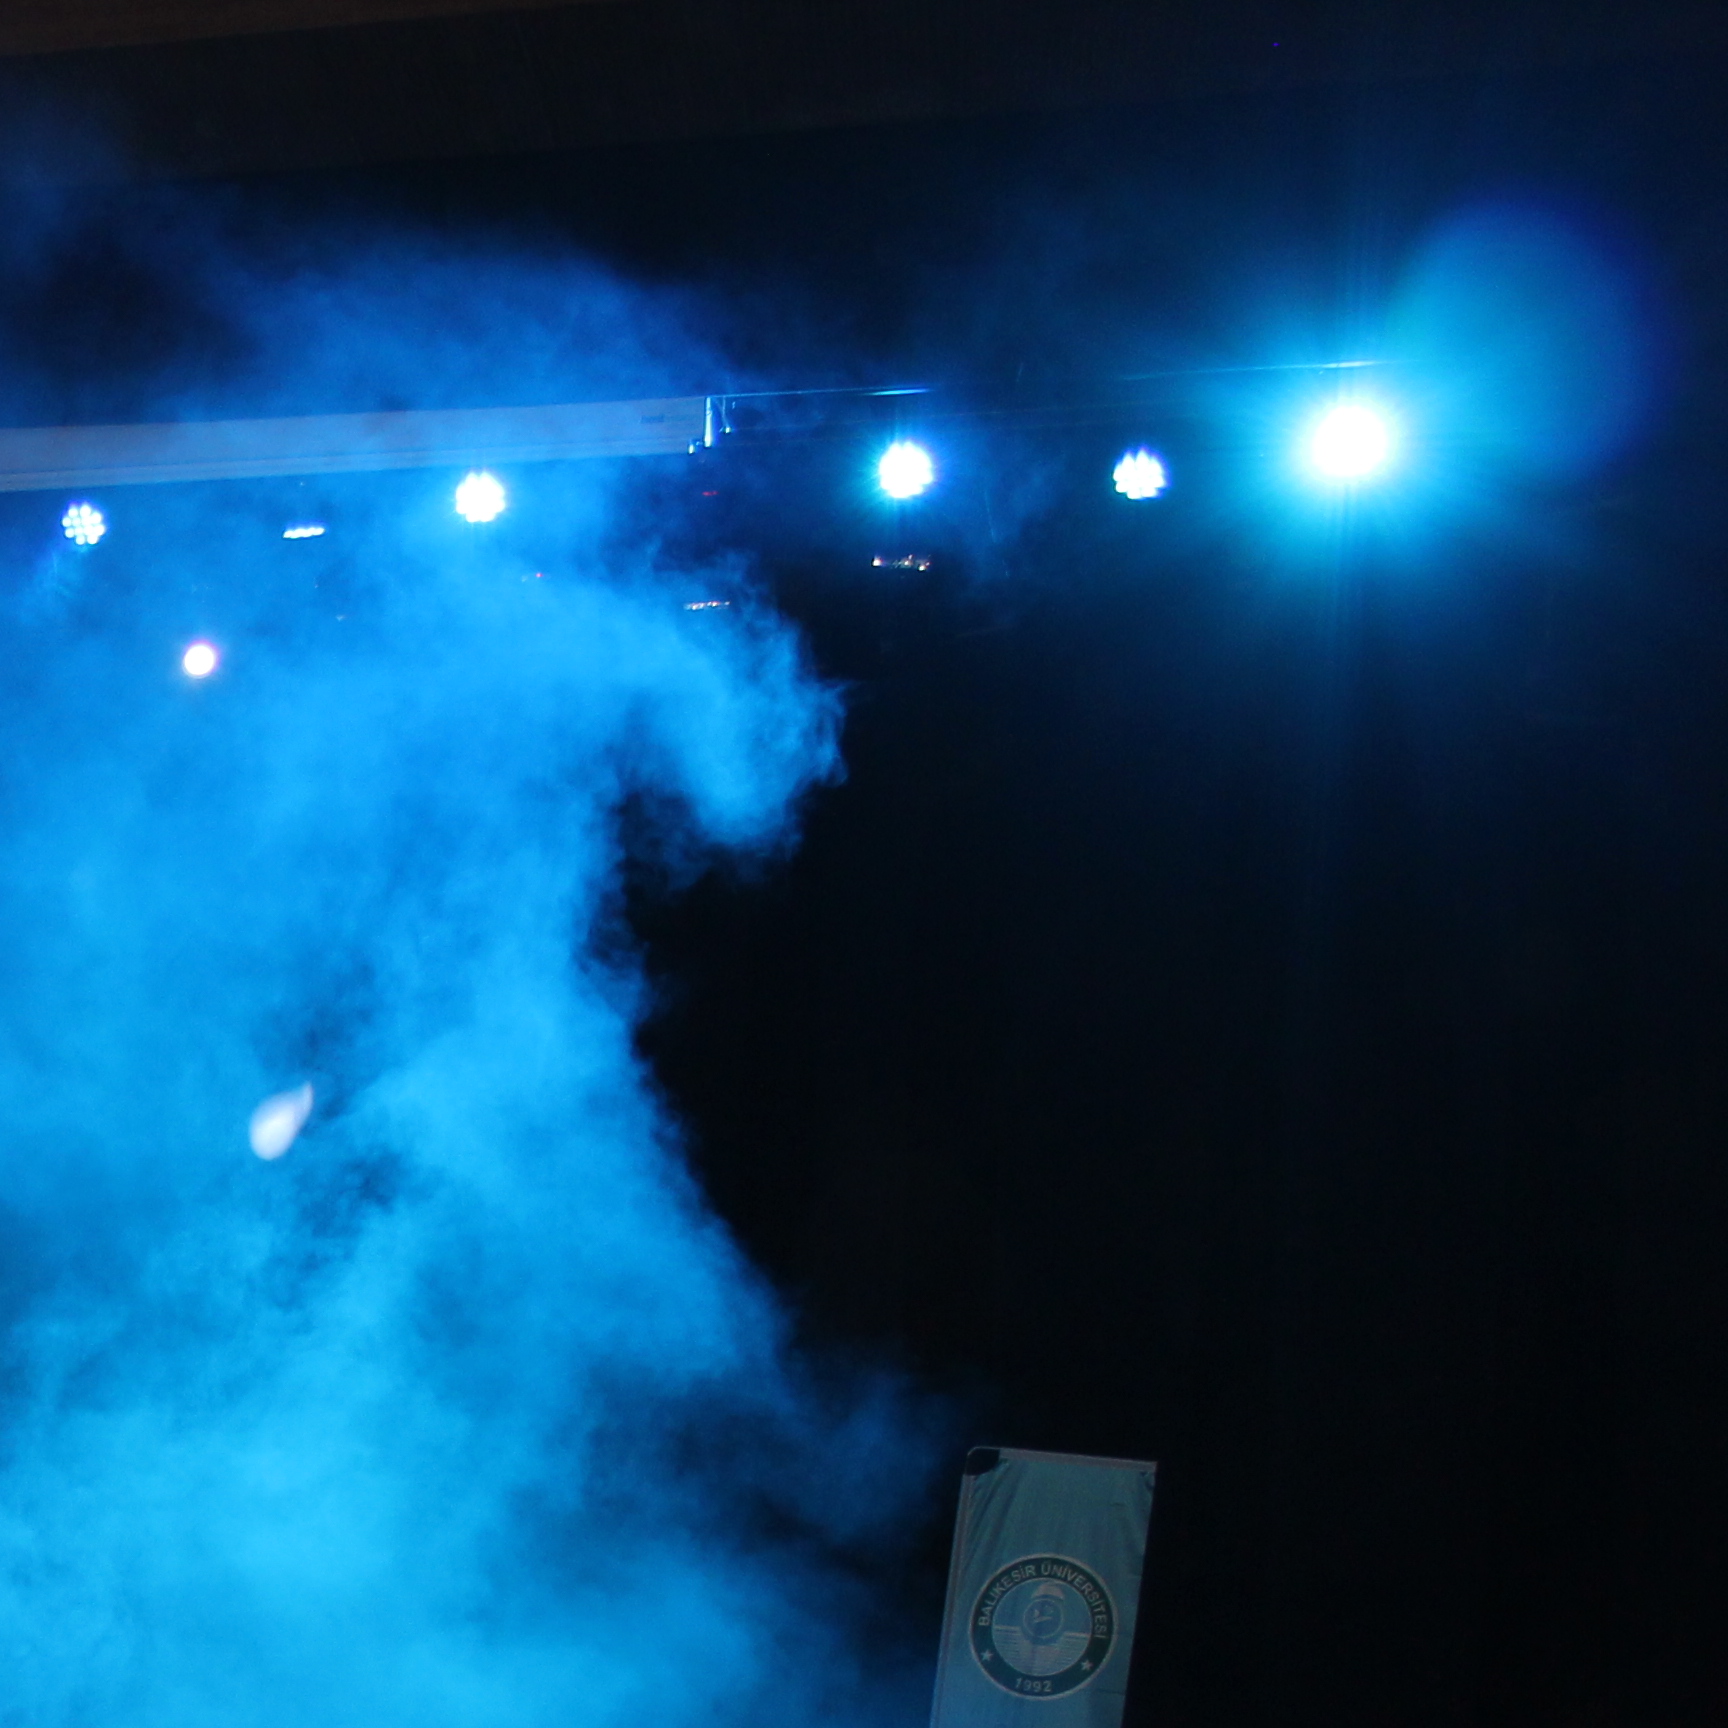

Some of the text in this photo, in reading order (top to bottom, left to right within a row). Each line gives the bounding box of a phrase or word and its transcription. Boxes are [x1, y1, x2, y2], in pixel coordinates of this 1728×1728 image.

[977, 1560, 1109, 1639] BALIKESİR ÜNİVERSİTESİ
[1014, 1676, 1053, 1694] 1992
